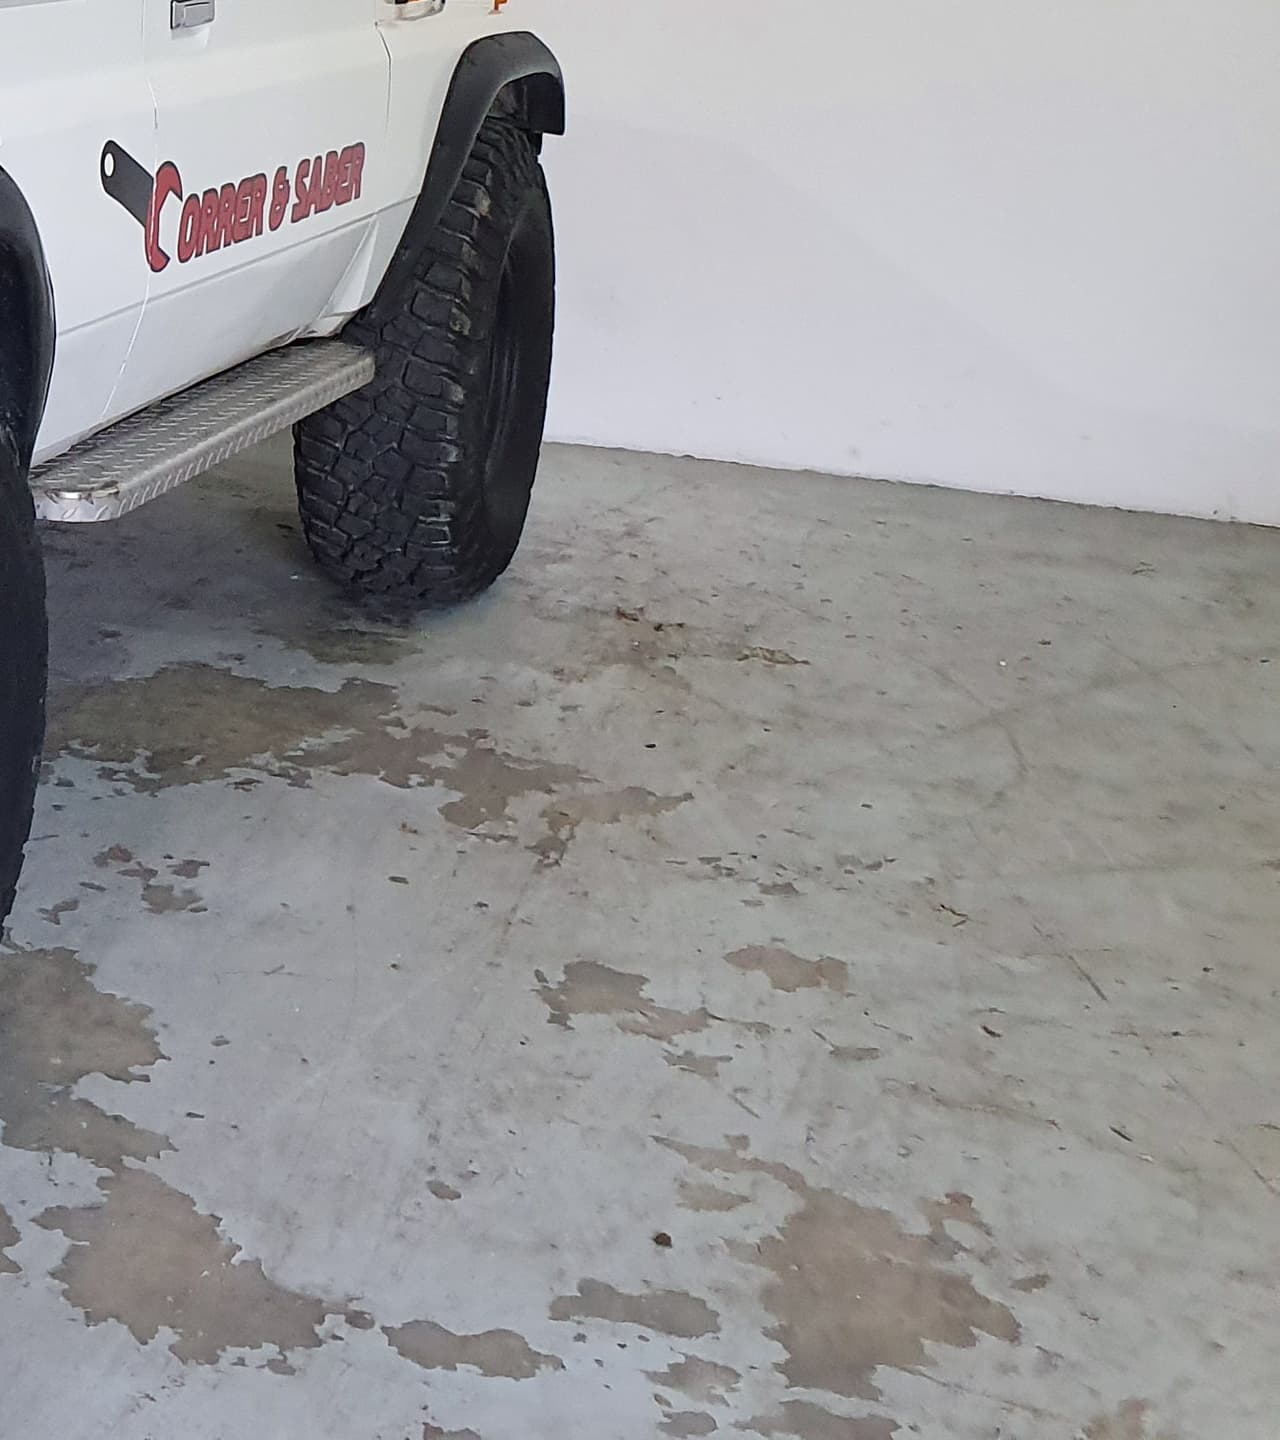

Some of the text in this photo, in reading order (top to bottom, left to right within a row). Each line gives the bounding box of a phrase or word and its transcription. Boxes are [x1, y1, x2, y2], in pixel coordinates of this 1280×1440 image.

[144, 141, 366, 273] CORRER & SABER
